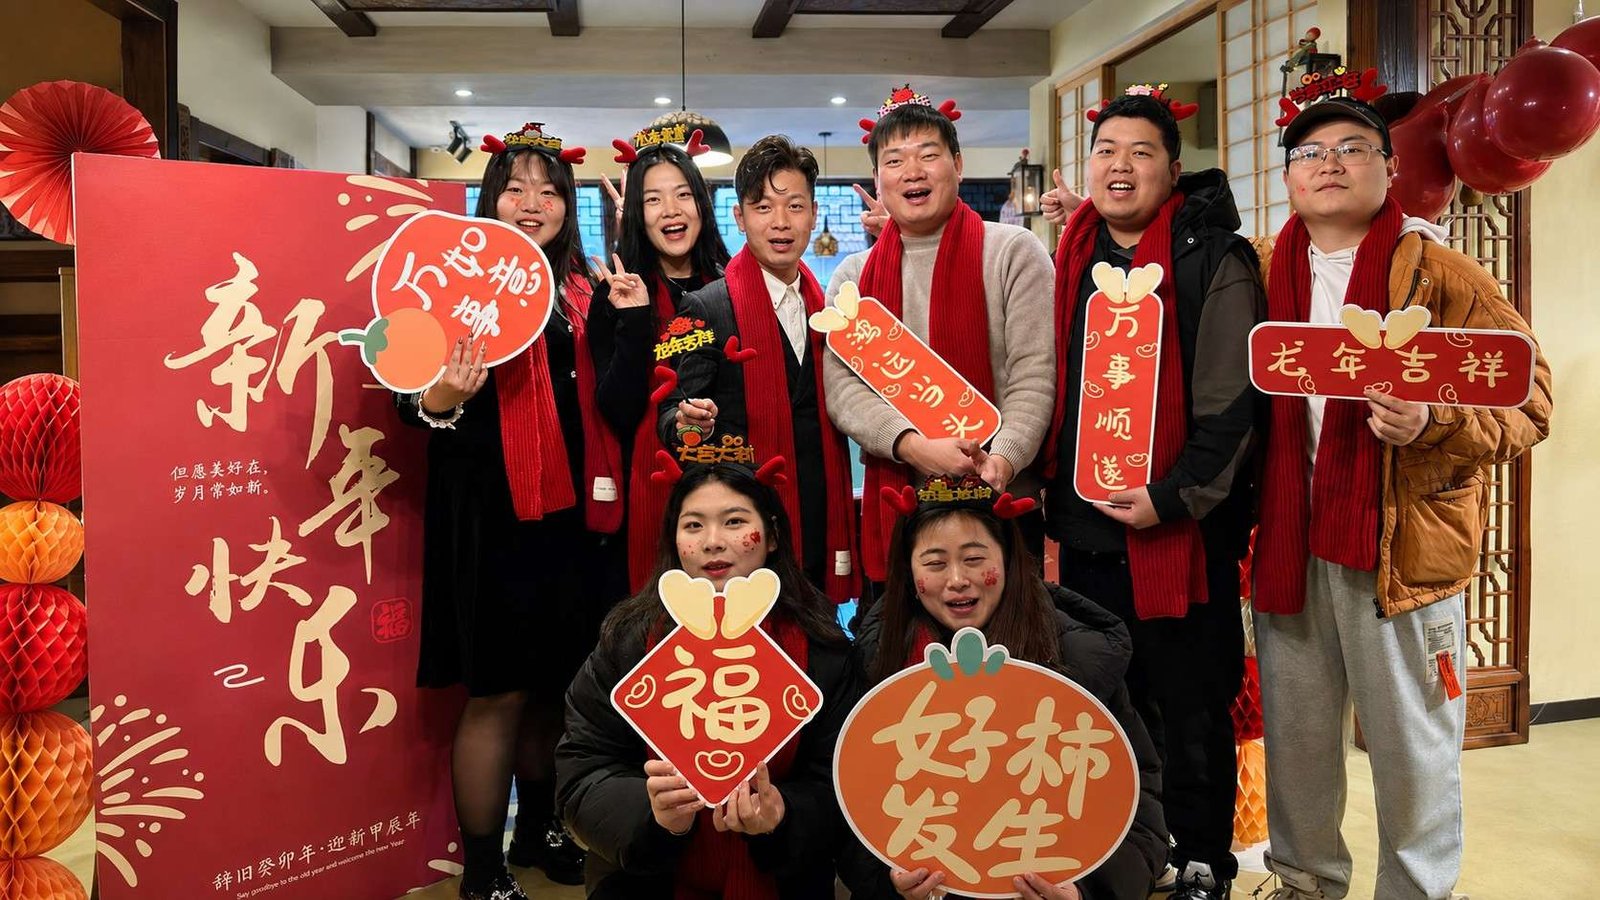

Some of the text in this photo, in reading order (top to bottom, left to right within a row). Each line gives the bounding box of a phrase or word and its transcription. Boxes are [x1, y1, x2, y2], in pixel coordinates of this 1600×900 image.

[845, 315, 985, 438] 鸿运当头
[1093, 303, 1140, 491] 万事顺遂
[1267, 340, 1509, 388] 龙年吉祥
[676, 444, 755, 464] 大吉大利
[661, 644, 771, 744] 福
[236, 891, 250, 900] Say
[251, 882, 280, 896] goodbye
[288, 875, 299, 883] the
[300, 870, 311, 879] old
